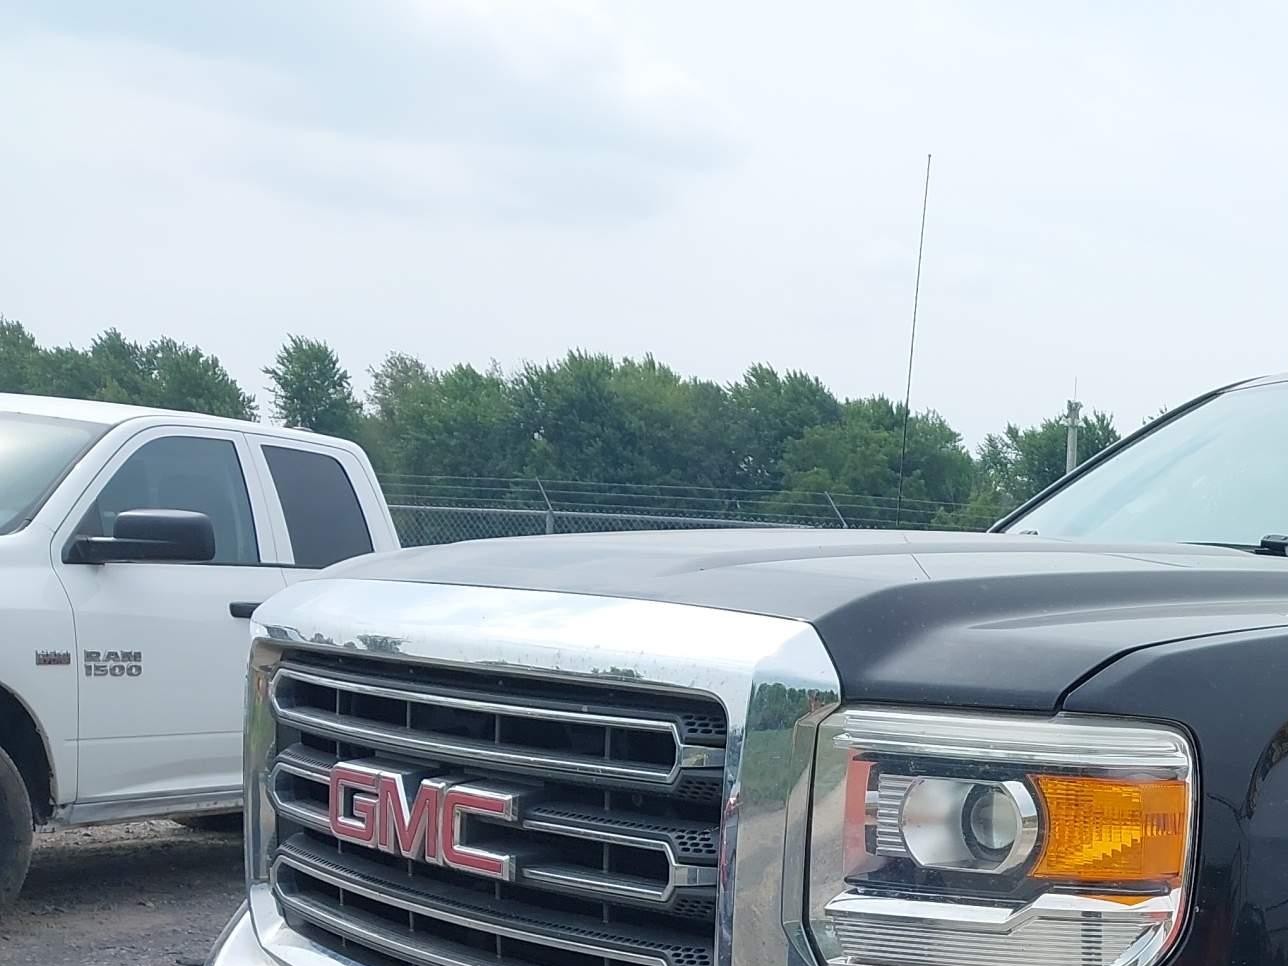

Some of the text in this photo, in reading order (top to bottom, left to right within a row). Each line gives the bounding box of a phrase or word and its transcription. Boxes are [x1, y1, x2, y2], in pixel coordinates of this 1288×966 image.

[84, 650, 142, 663] RAM
[84, 664, 143, 677] 1500
[329, 761, 517, 881] GMC
